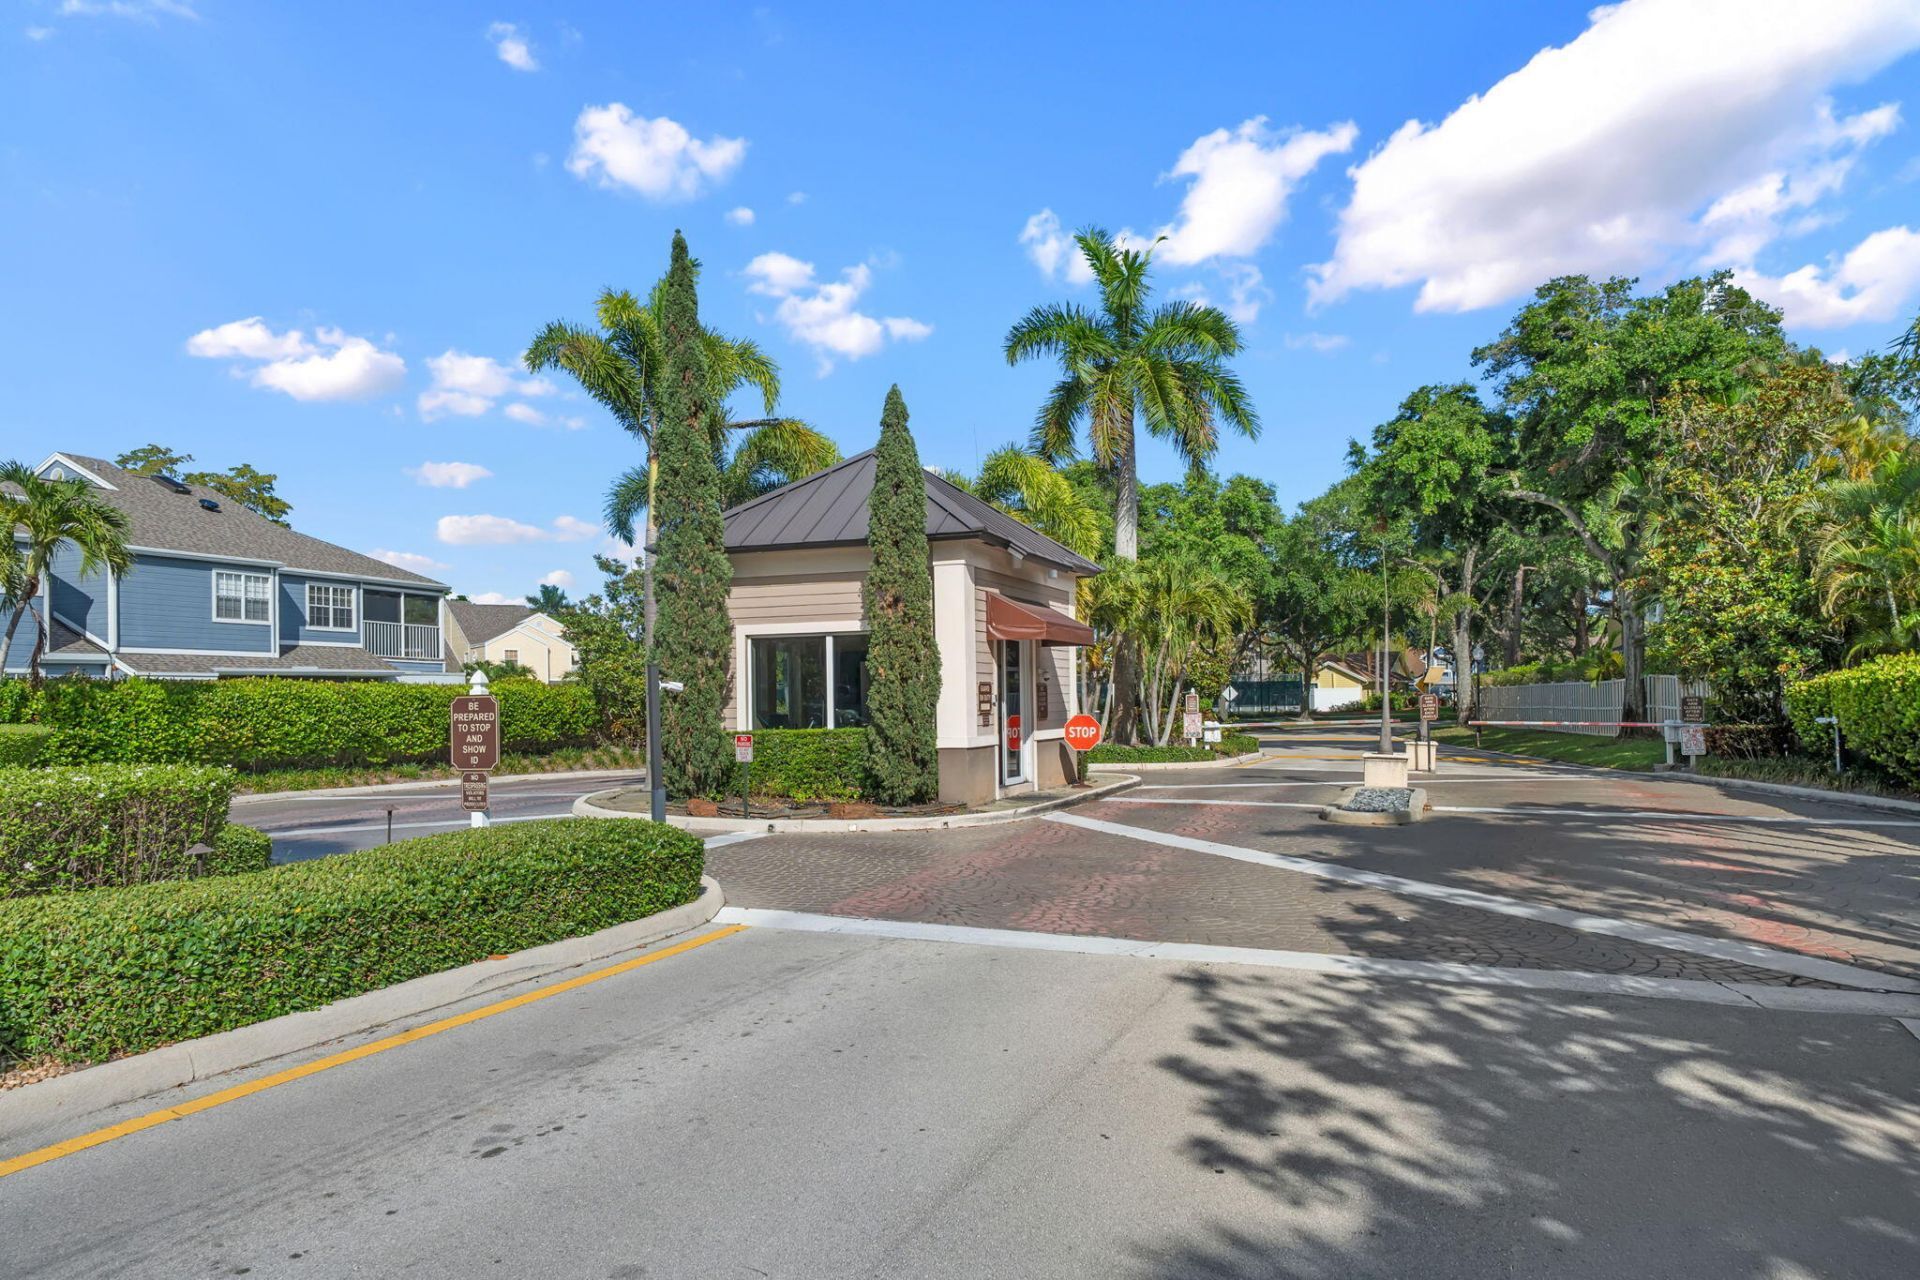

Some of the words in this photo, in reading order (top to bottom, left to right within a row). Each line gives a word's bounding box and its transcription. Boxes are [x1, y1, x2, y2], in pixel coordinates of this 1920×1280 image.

[468, 702, 479, 711] BE
[453, 712, 495, 721] PREPARED
[458, 724, 468, 732] TO
[470, 723, 491, 732] STOP
[1068, 726, 1097, 738] STOP
[466, 734, 483, 743] AND
[462, 745, 487, 754] SHOW
[470, 756, 479, 764] ID
